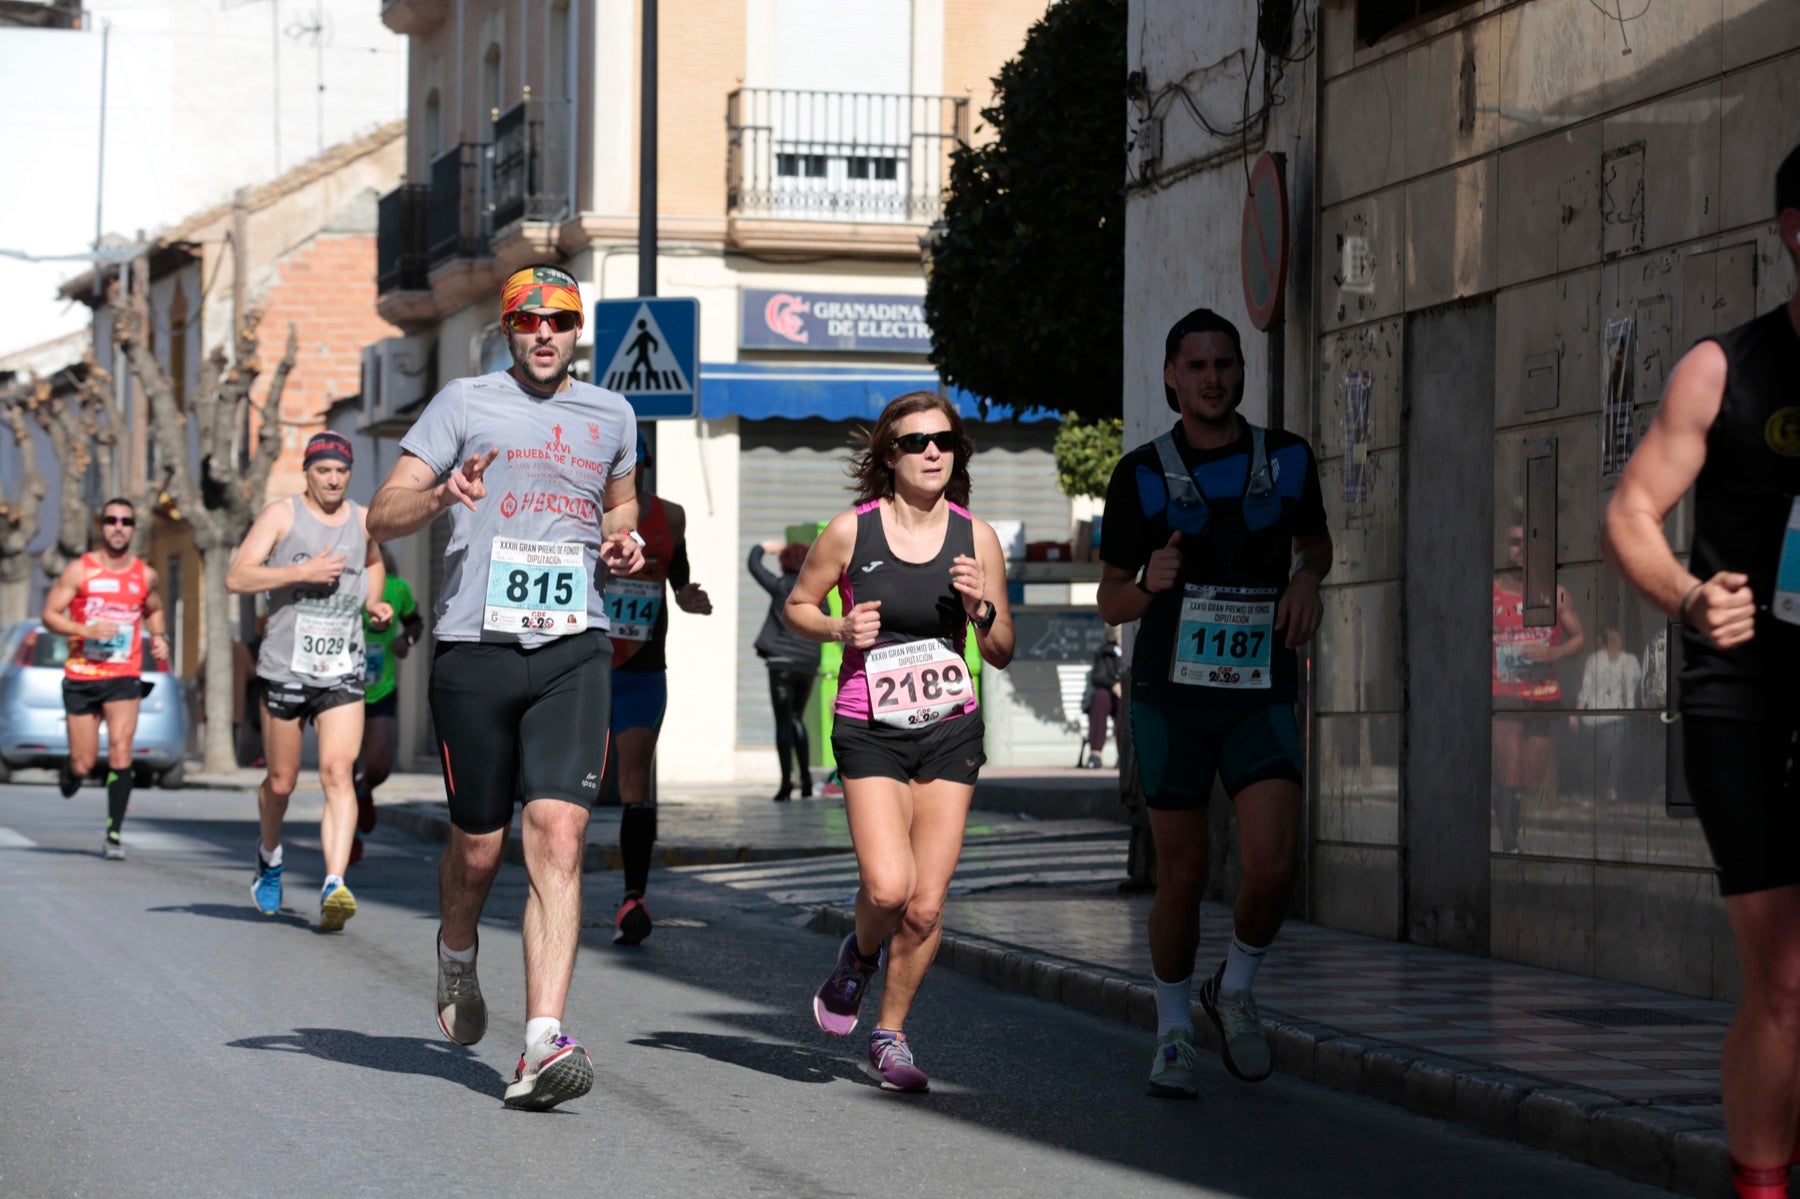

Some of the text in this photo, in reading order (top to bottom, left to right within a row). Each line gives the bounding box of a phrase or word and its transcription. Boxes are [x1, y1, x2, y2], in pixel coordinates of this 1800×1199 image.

[813, 302, 923, 320] GRANADINA
[828, 320, 854, 336] DE
[546, 441, 571, 454] XXVI
[507, 449, 604, 475] PRUEBA DE FONDO
[500, 541, 518, 552] XXXIII
[519, 543, 536, 553] GRAN
[556, 546, 563, 555] DE
[506, 569, 573, 605] 815
[611, 598, 653, 622] 114
[1207, 604, 1224, 612] GRAN
[1225, 605, 1247, 614] PREMIO
[1247, 606, 1255, 614] DE
[303, 635, 345, 655] 3029
[888, 648, 905, 659] GRAN
[906, 644, 928, 655] PREMIO
[928, 642, 937, 651] DE
[1191, 627, 1265, 659] 1187
[875, 665, 963, 707] 2189
